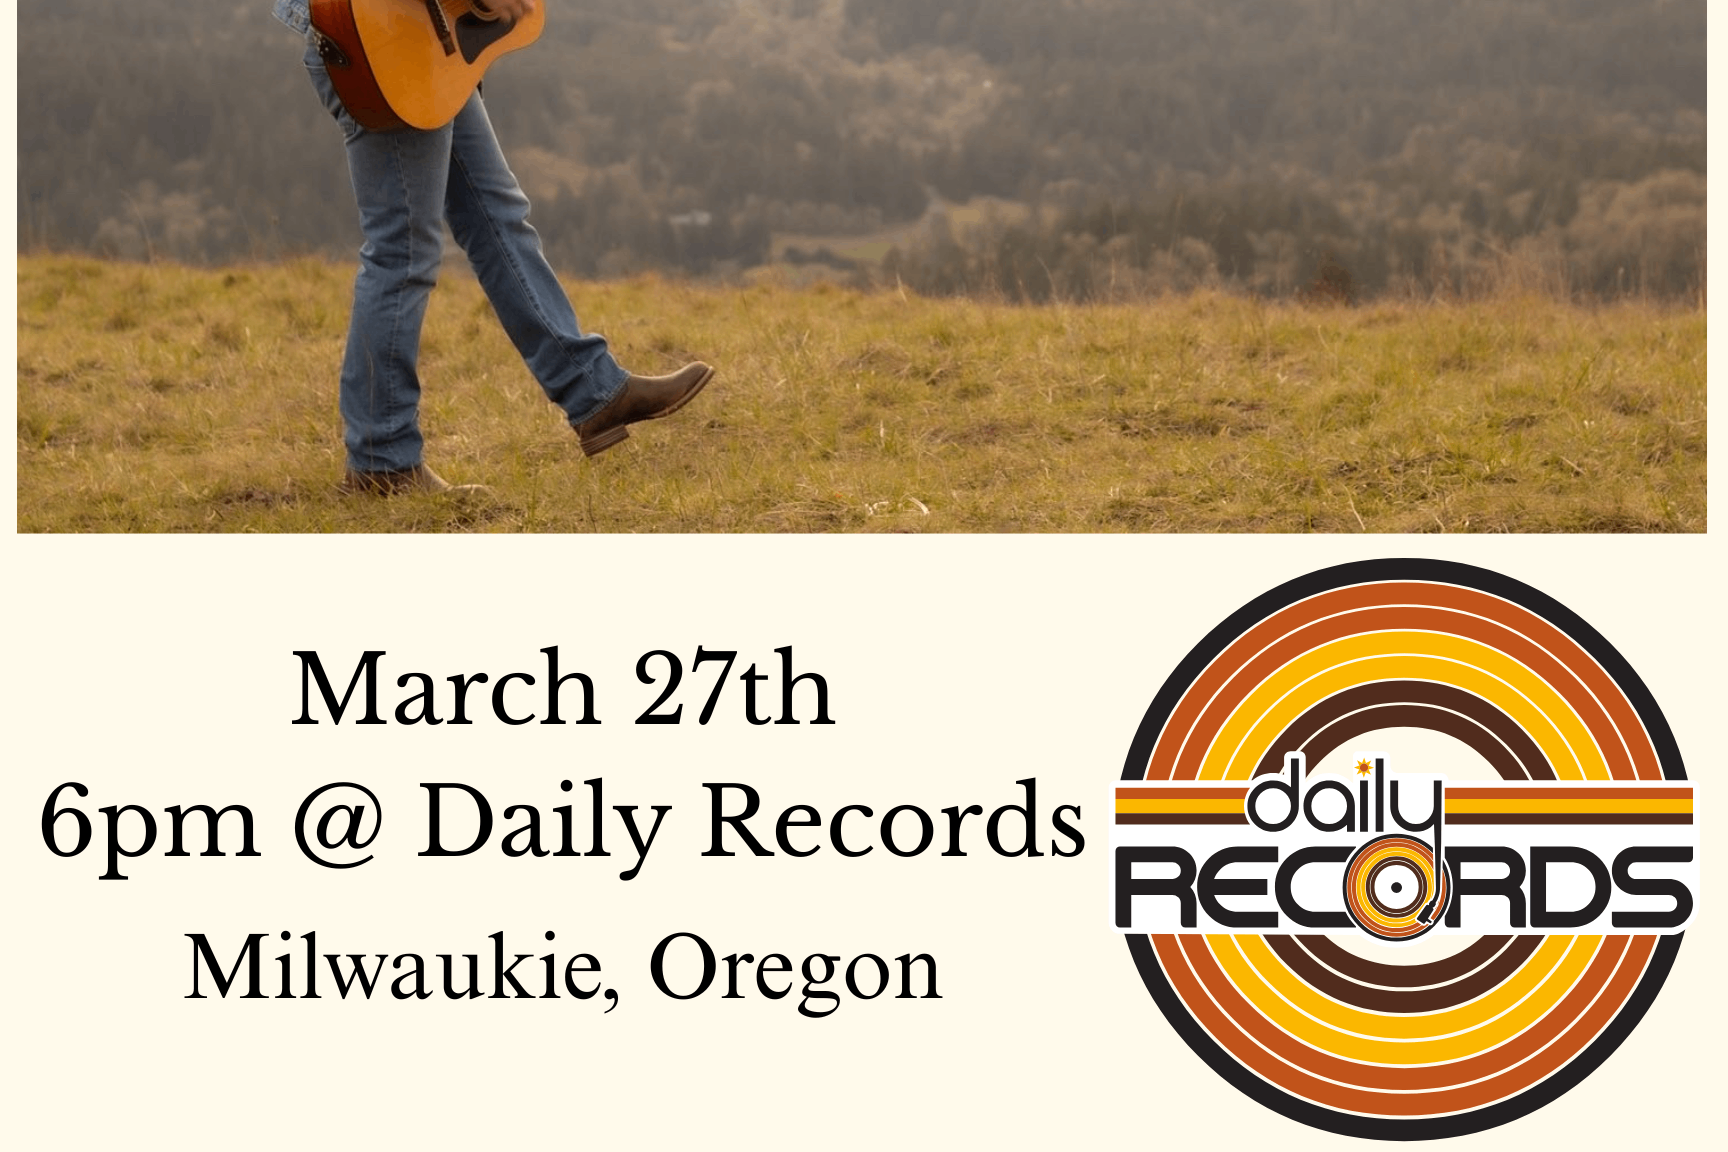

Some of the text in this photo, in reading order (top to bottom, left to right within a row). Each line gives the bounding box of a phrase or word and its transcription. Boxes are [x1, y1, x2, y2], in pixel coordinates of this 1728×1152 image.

[292, 645, 835, 725] March 27th
[42, 778, 1085, 881] 6pm @ Daily Records
[1247, 757, 1442, 901] daily
[1115, 834, 1693, 942] RECORDS
[185, 931, 942, 1018] Milwaukie, Oregon
